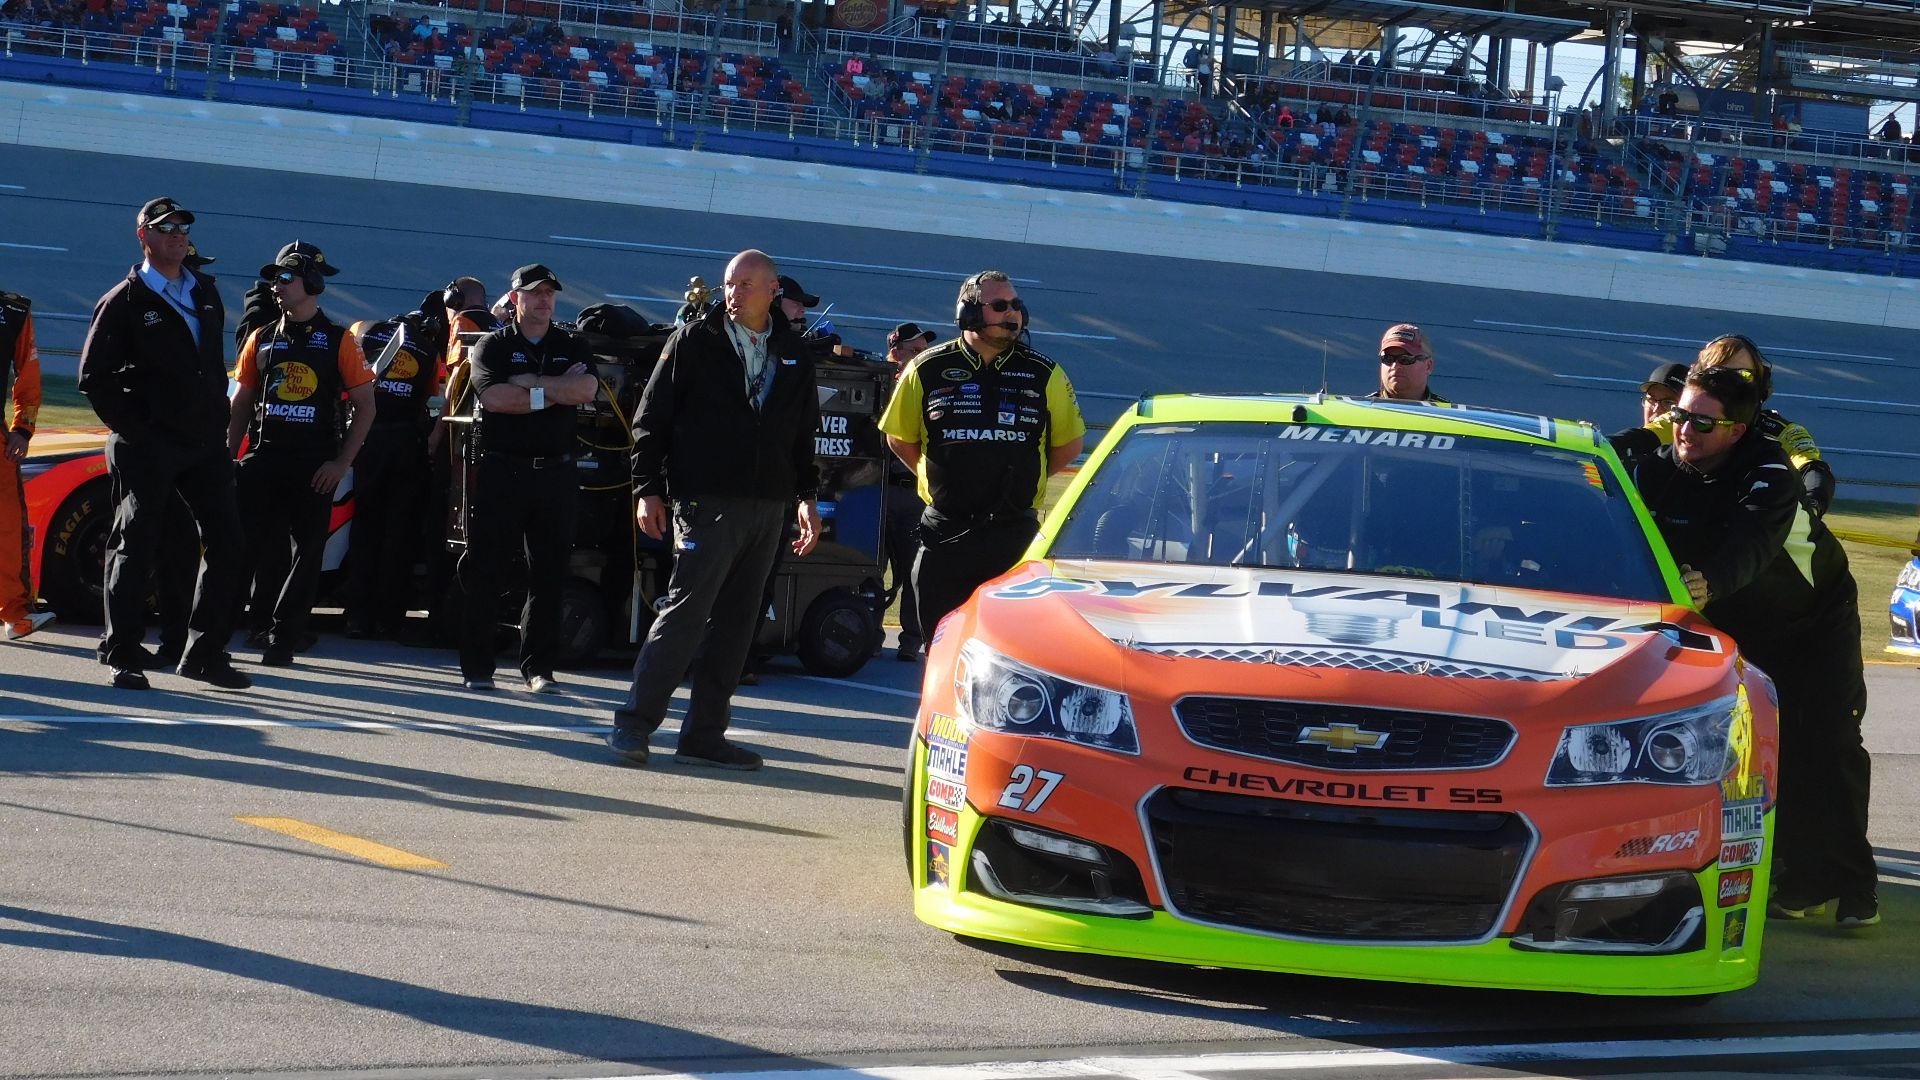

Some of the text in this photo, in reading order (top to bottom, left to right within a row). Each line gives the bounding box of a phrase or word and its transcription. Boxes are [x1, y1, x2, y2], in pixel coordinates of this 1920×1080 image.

[286, 362, 309, 375] Bass
[286, 374, 303, 384] Pro
[1001, 371, 1035, 379] MENARDS
[286, 383, 313, 396] Shops
[265, 403, 316, 418] RACKER
[815, 415, 848, 434] VER
[942, 428, 1027, 442] MENARDS
[1277, 425, 1456, 451] MENARD
[55, 500, 93, 557] EAGLE
[1421, 609, 1628, 650] LED
[927, 744, 967, 777] MAHLE
[928, 779, 955, 799] COMP
[997, 763, 1066, 813] 27
[1183, 766, 1503, 804] CHEVROLET SS
[1722, 805, 1762, 834] MAHLE
[1648, 829, 1700, 854] RCR
[1721, 843, 1750, 864] COMP
